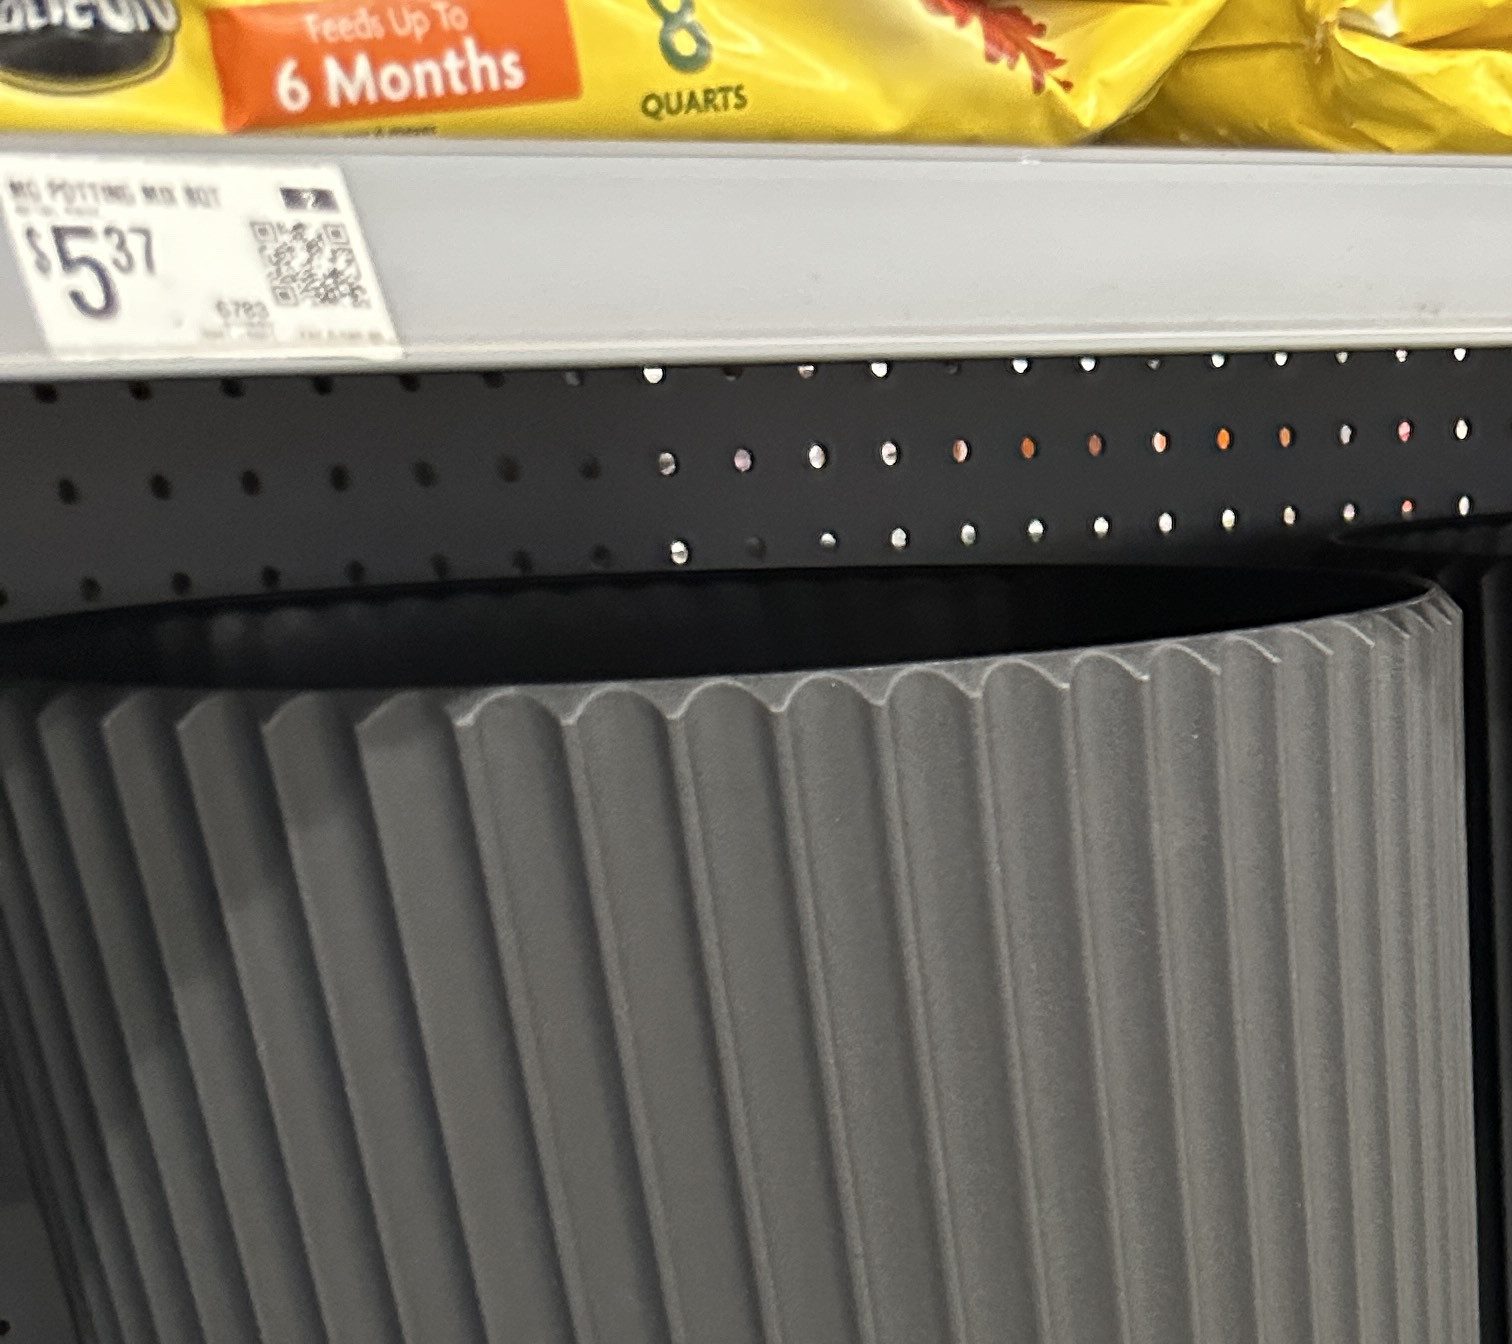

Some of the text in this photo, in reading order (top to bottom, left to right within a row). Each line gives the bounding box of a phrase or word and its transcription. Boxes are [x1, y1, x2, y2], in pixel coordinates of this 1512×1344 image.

[304, 0, 469, 43] Feeds Up To
[647, 0, 713, 75] 8
[275, 35, 526, 113] 6 Months
[641, 84, 748, 121] QUARTS
